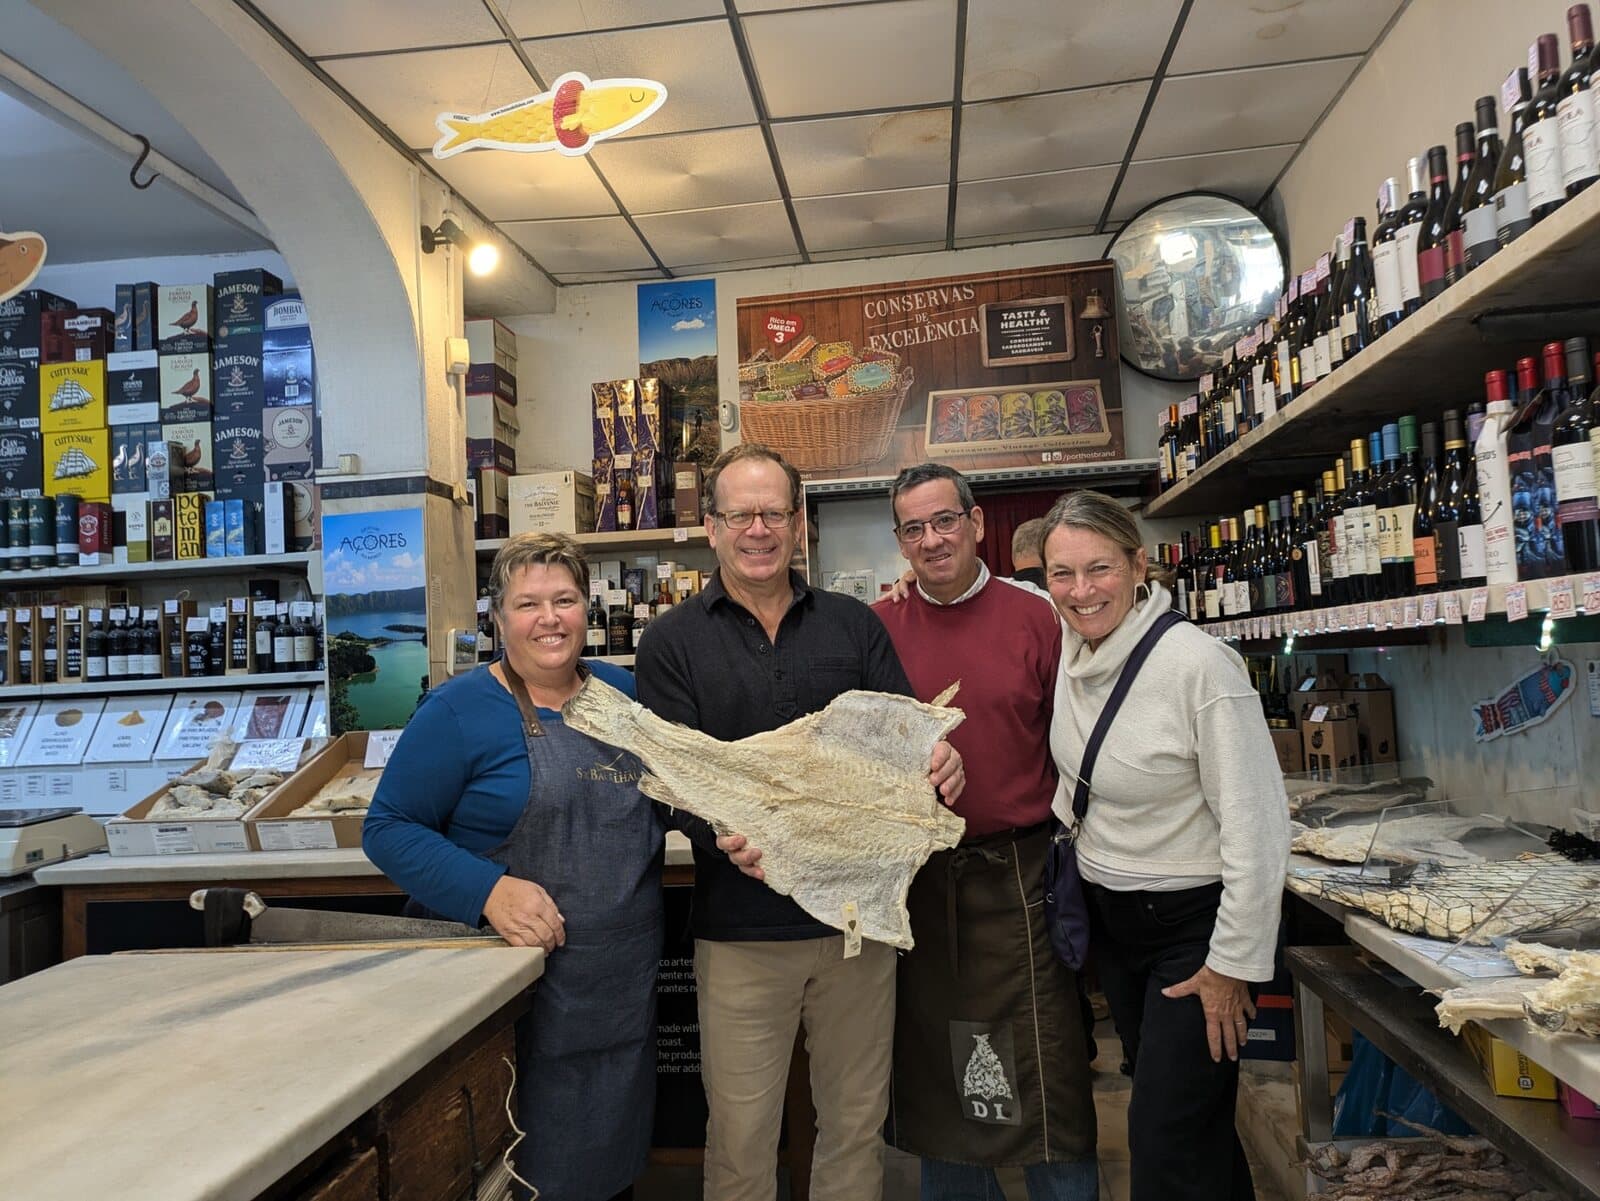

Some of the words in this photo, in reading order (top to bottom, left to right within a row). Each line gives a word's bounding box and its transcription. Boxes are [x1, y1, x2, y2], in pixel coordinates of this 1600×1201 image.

[217, 283, 260, 298] JAMESON
[650, 297, 703, 312] AÇORES
[864, 283, 975, 319] CONSERVAS
[273, 304, 303, 316] BOMBAY
[1001, 310, 1036, 320] TASTY
[1039, 309, 1047, 317] &
[770, 316, 785, 325] Rico
[914, 311, 929, 324] DE
[1000, 317, 1050, 329] HEALTHY
[774, 332, 785, 343] 3
[869, 317, 980, 351] EXCELÊNCIA
[213, 355, 260, 370] JAMESON
[50, 367, 72, 378] CUTTY
[71, 367, 90, 376] SARK
[54, 435, 75, 446] CUTTY
[74, 434, 94, 445] SARK
[214, 427, 261, 442] JAMESON
[339, 532, 407, 556] AÇORES
[656, 1064, 681, 1073] other
